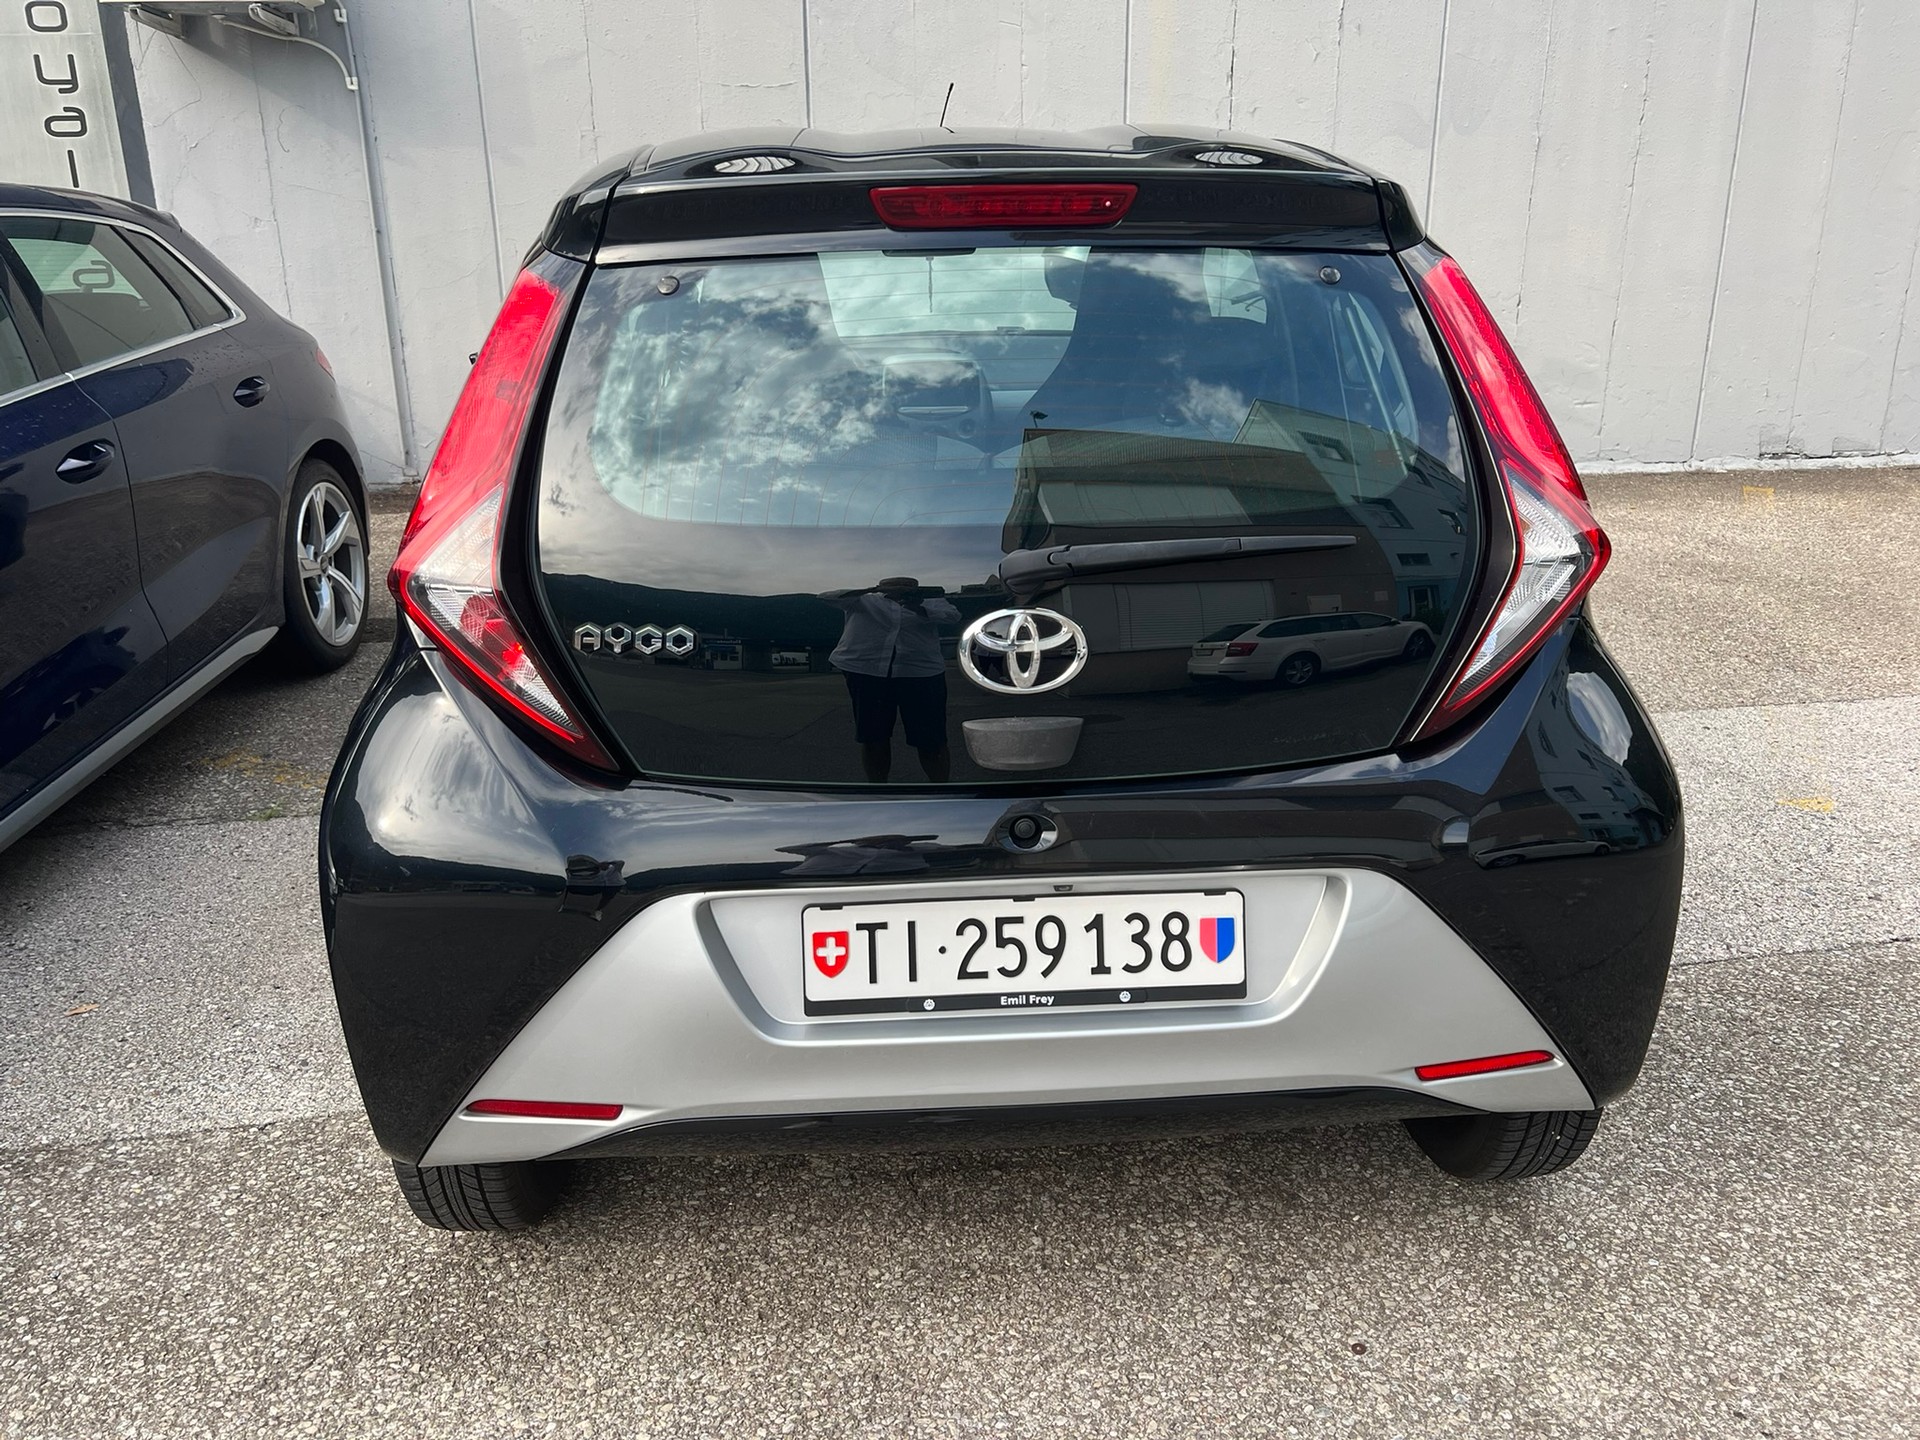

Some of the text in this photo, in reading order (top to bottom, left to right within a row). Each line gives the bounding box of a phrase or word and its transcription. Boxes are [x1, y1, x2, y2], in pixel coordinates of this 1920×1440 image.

[574, 623, 695, 655] AYGO
[1001, 994, 1055, 1006] Emil Frey
